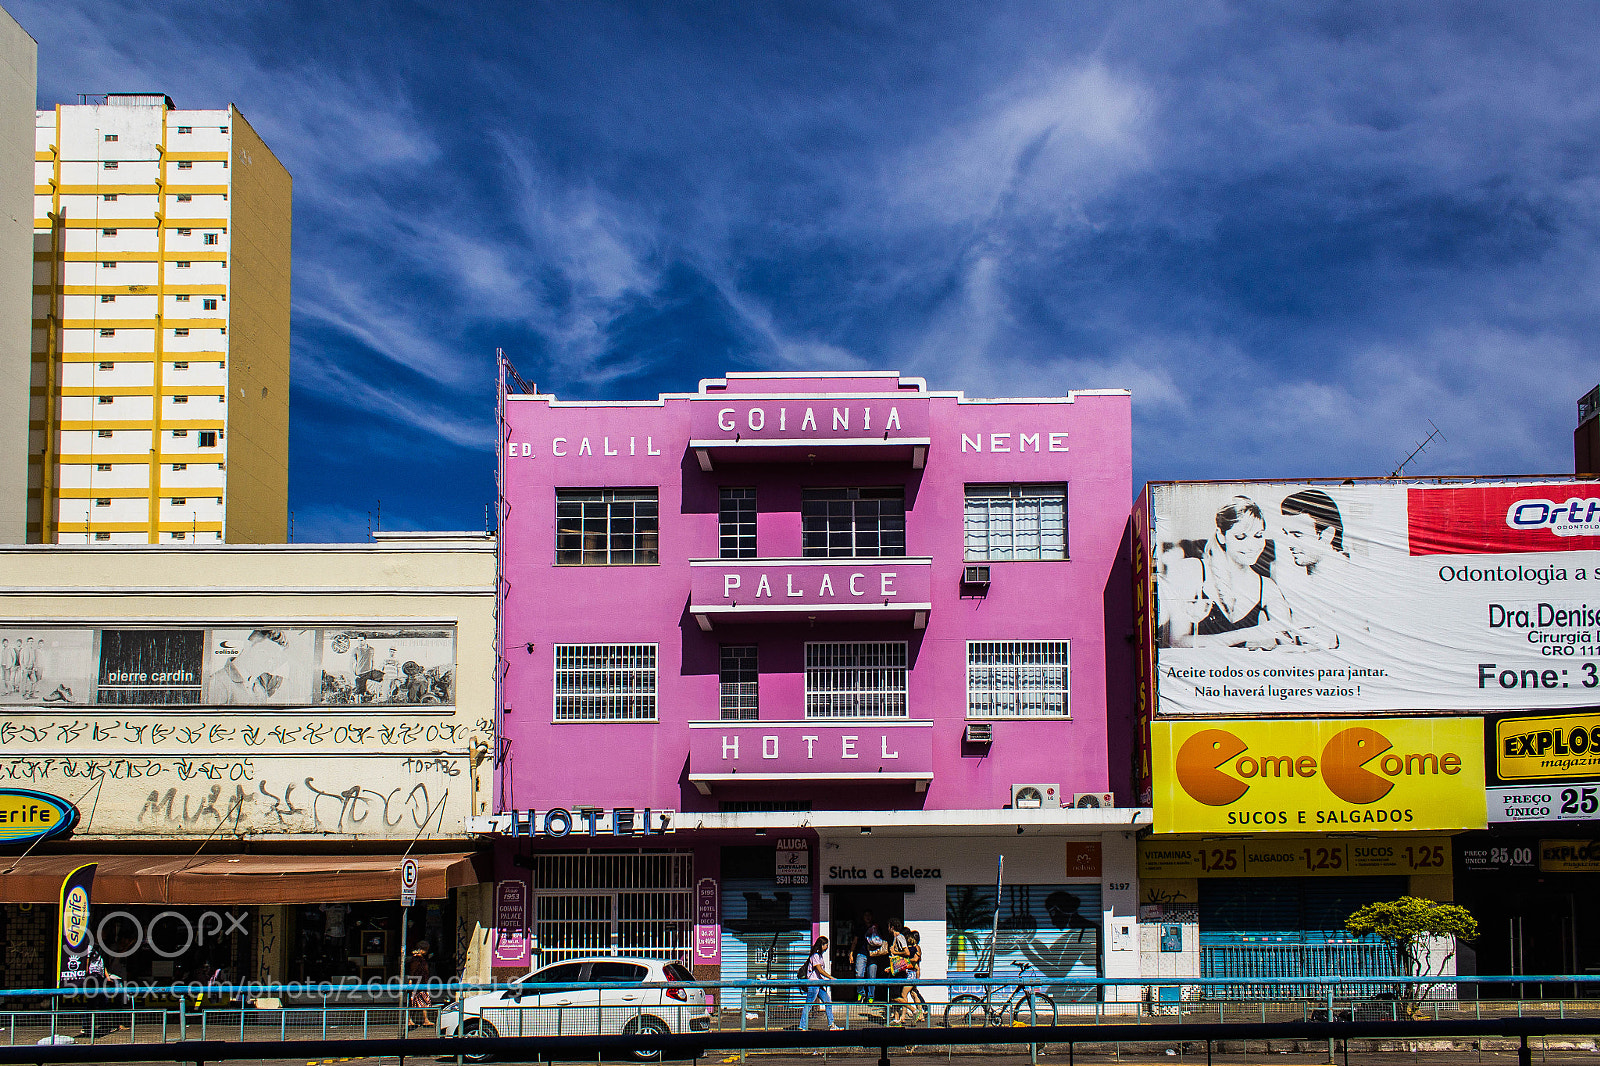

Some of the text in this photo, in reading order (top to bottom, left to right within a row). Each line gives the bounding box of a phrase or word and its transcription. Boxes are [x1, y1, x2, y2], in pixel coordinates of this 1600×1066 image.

[718, 407, 901, 431] GOIANIA
[552, 436, 661, 457] CALIL
[961, 433, 1070, 453] NEME
[1438, 564, 1568, 586] Odontologia
[1574, 567, 1587, 581] a
[723, 572, 897, 598] PALACE
[1135, 507, 1149, 780] DENTISTA
[1527, 630, 1592, 645] Cirurgiã
[1541, 645, 1575, 656] CRO
[108, 669, 194, 683] pierre cardin
[1167, 665, 1389, 681] Aceite todos os convites para jantar.
[1478, 662, 1600, 689] Fone: 3
[1194, 686, 1220, 697] Não
[1223, 684, 1265, 697] haverá
[1268, 684, 1313, 700] lugares
[1315, 685, 1354, 697] vazios
[722, 735, 899, 760] HOTEL
[1503, 787, 1599, 814] PREÇO 25
[0, 804, 51, 823] erife
[1227, 809, 1414, 825] SUCOS E SALGADOS
[1505, 805, 1550, 817] ÚNICO
[511, 807, 665, 838] HOTEL
[776, 838, 808, 850] ALUGA
[1145, 848, 1238, 873] VITAMINAS 1,25
[1248, 847, 1342, 872] SALGADOS 1,25
[1354, 845, 1445, 870] SUCOS 1,25
[1464, 847, 1532, 866] PREÇO 25,00
[1465, 857, 1487, 865] ÚNICO
[406, 865, 413, 883] E
[828, 865, 942, 879] Sinta a Beleza
[1109, 882, 1130, 891] 5197
[68, 893, 82, 943] sherife
[500, 912, 522, 920] PALACE
[61, 970, 86, 978] KINGS
